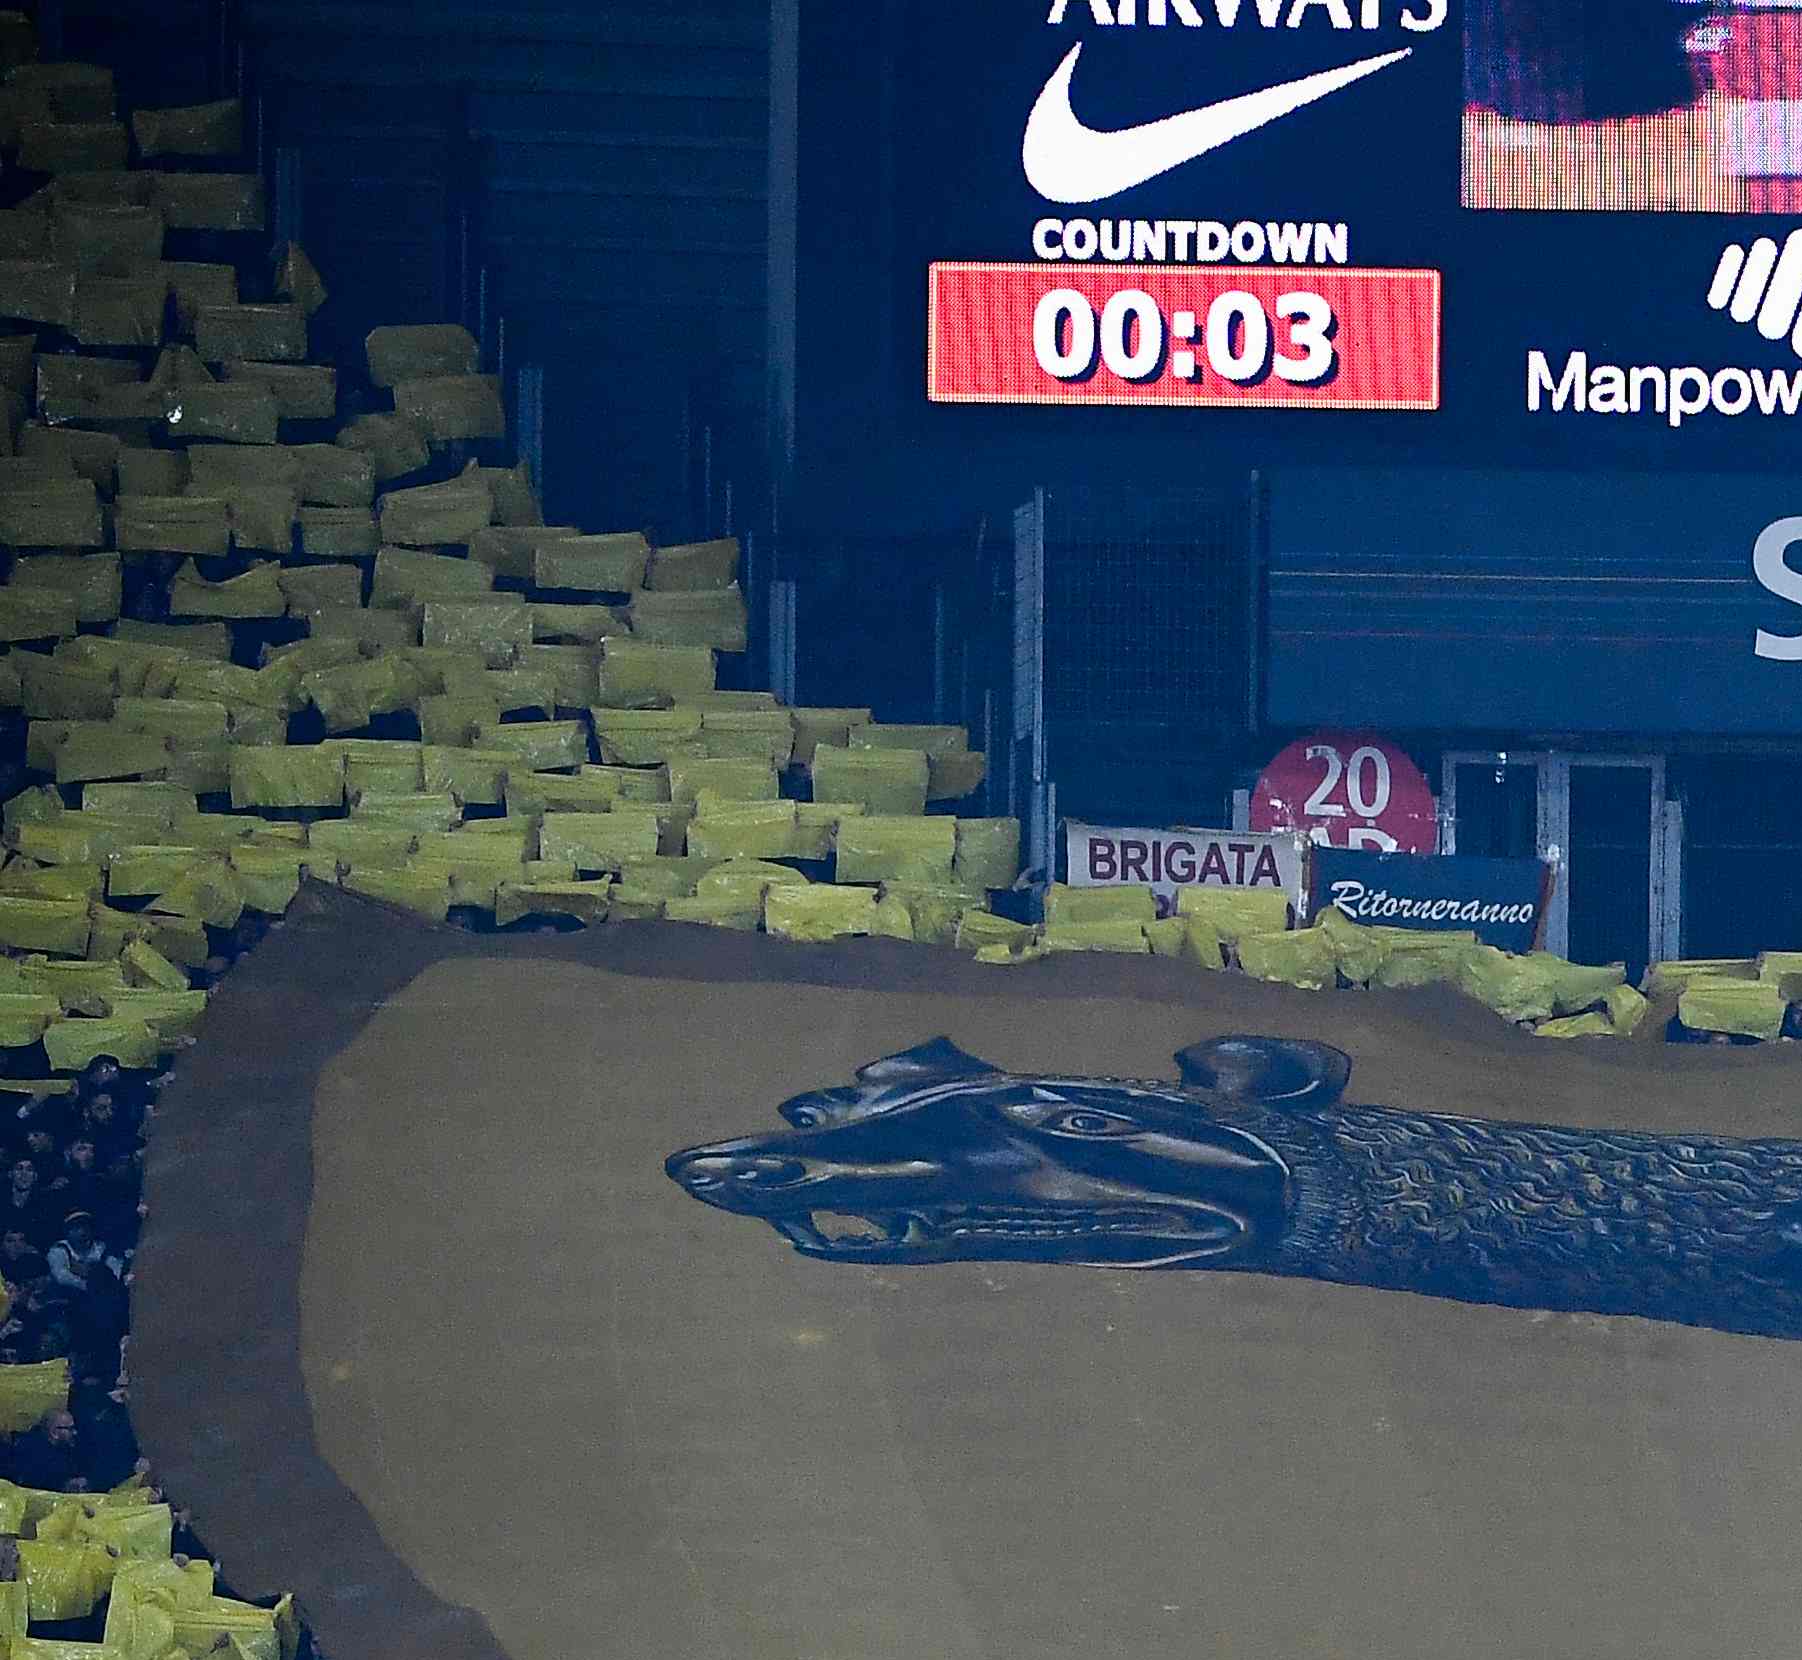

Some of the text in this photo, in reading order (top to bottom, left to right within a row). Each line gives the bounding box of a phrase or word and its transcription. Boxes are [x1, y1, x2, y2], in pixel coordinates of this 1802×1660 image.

[1033, 219, 1348, 263] COUNTDOWN
[1033, 288, 1336, 384] 00:03
[1303, 745, 1391, 818] 20
[1089, 837, 1282, 887] BRIGATA
[1330, 880, 1534, 924] Ritorneranno
